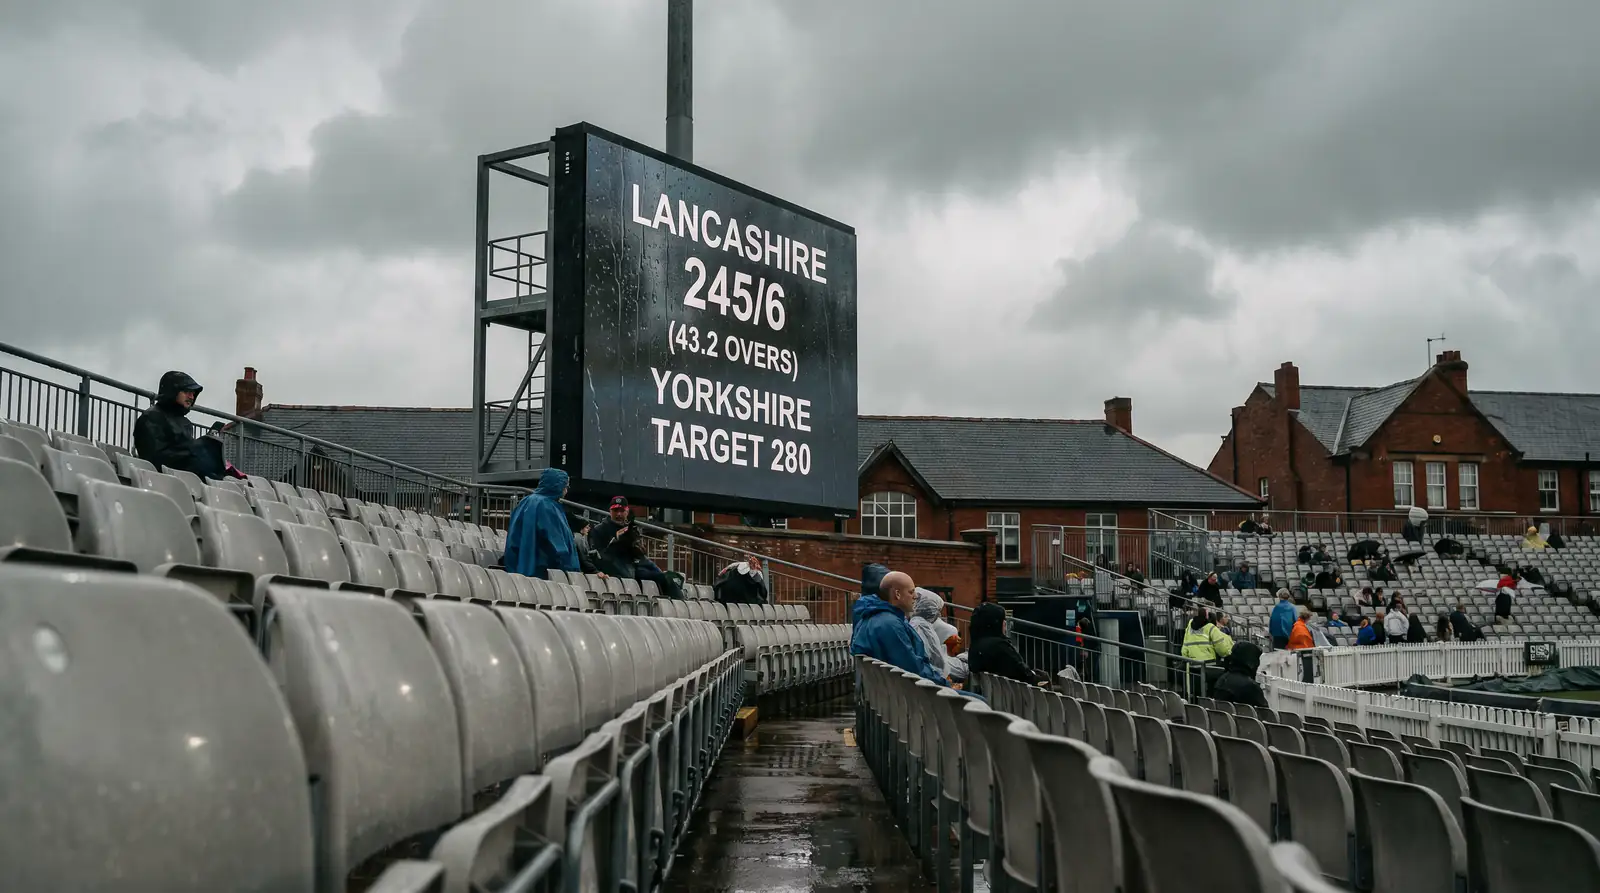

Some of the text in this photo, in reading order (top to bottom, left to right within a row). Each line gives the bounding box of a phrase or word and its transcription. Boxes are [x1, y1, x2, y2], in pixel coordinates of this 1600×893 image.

[632, 183, 827, 285] LANCASHIRE
[683, 257, 786, 331] 245/6
[668, 320, 798, 383] (43.2 OVERS)
[650, 367, 812, 432] YORKSHIRE
[650, 418, 811, 476] TARGET 280
